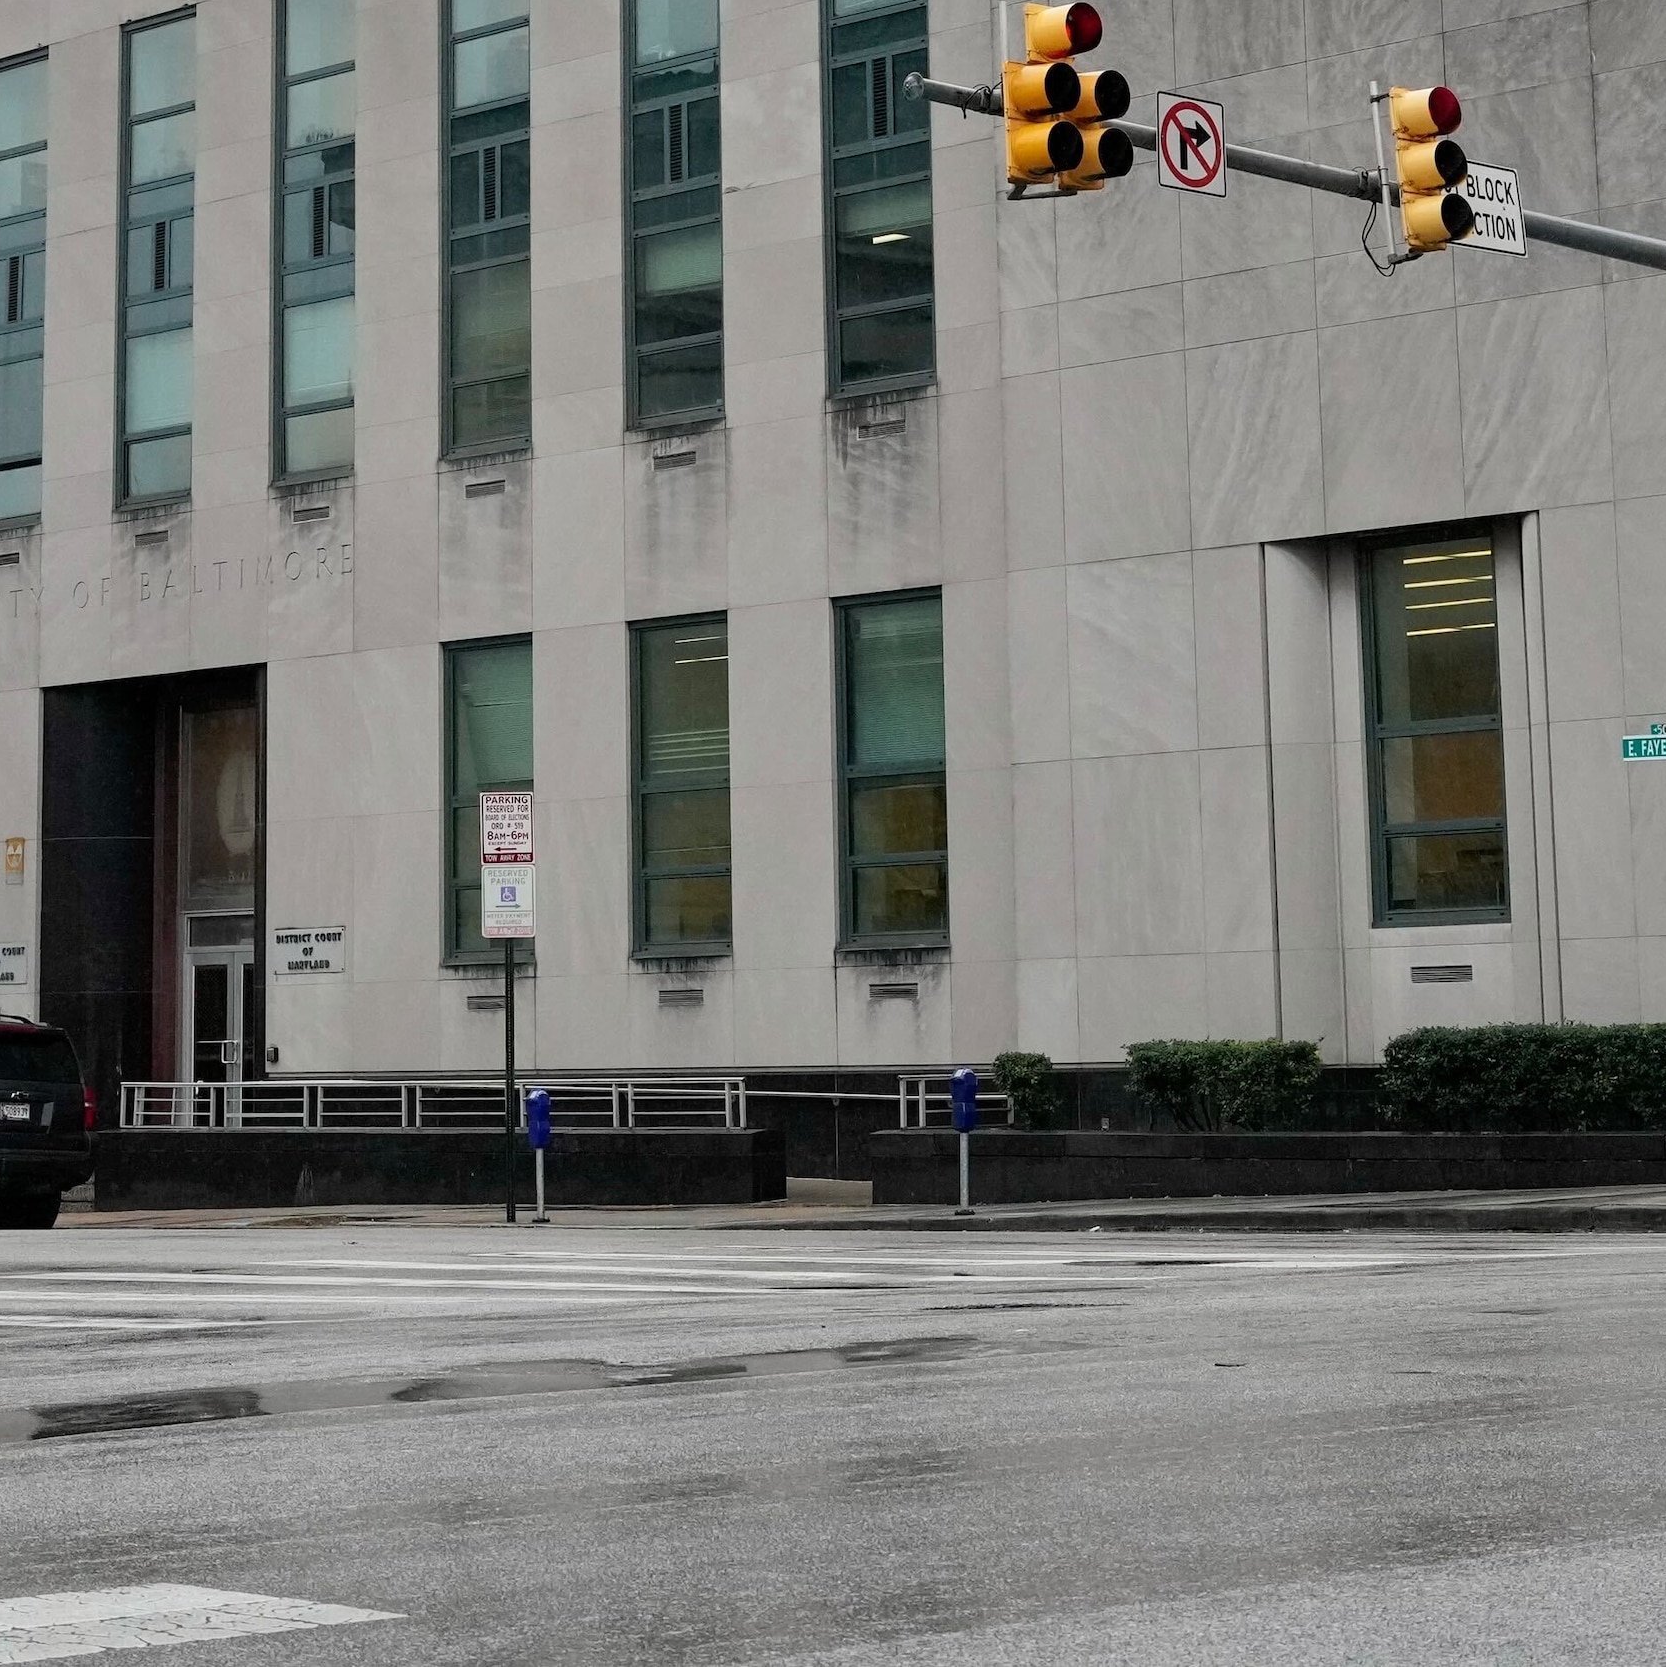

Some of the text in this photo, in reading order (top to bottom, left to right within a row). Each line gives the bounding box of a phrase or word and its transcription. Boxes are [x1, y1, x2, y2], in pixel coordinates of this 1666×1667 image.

[1466, 174, 1515, 206] BLOCK
[1473, 211, 1516, 242] CTION
[72, 577, 111, 608] OF
[140, 543, 353, 602] BALTIMORE
[1628, 740, 1638, 756] E.
[485, 796, 528, 804] PARKING
[486, 805, 529, 813] RESERVED FOR
[487, 830, 529, 841] 8AM-6PM
[485, 854, 498, 862] TOW
[517, 853, 531, 861] ZONE
[276, 932, 342, 944] DISTRICT COURT
[2, 946, 25, 956] COURT
[302, 947, 313, 956] OF
[288, 960, 330, 970] MARYLAND
